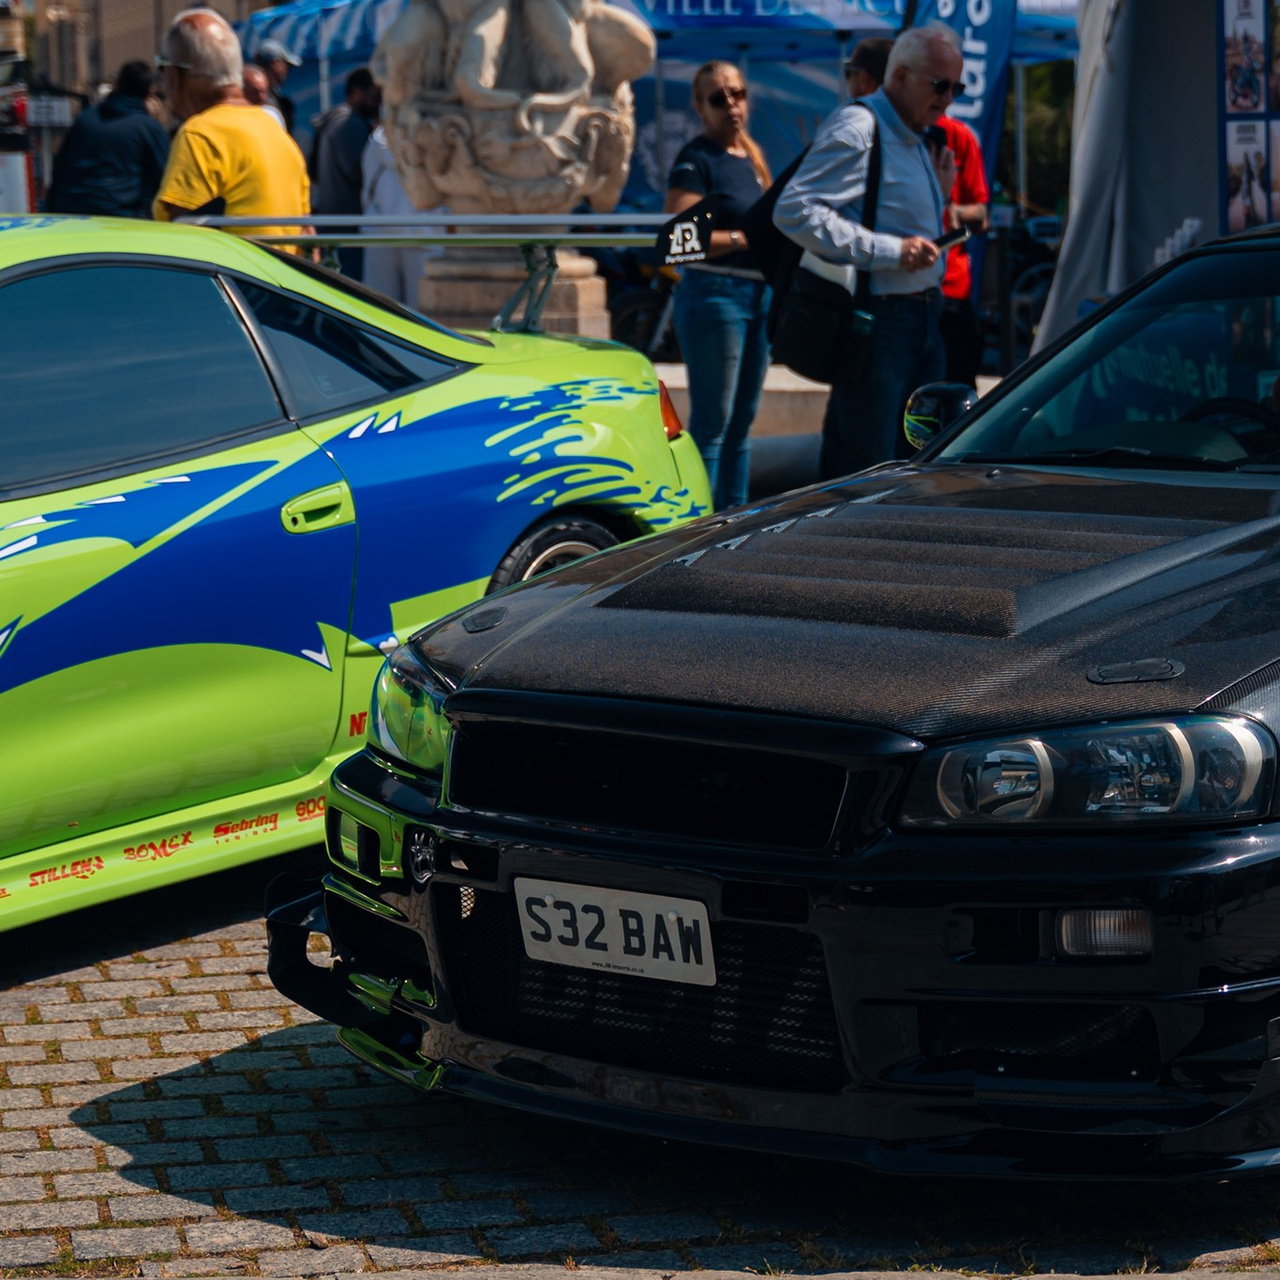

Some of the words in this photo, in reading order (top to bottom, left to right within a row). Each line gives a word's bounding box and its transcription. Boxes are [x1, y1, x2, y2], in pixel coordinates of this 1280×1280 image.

[213, 813, 279, 838] Sebring
[29, 858, 93, 887] STILLEN
[525, 896, 609, 953] S32
[618, 908, 704, 966] BAW
